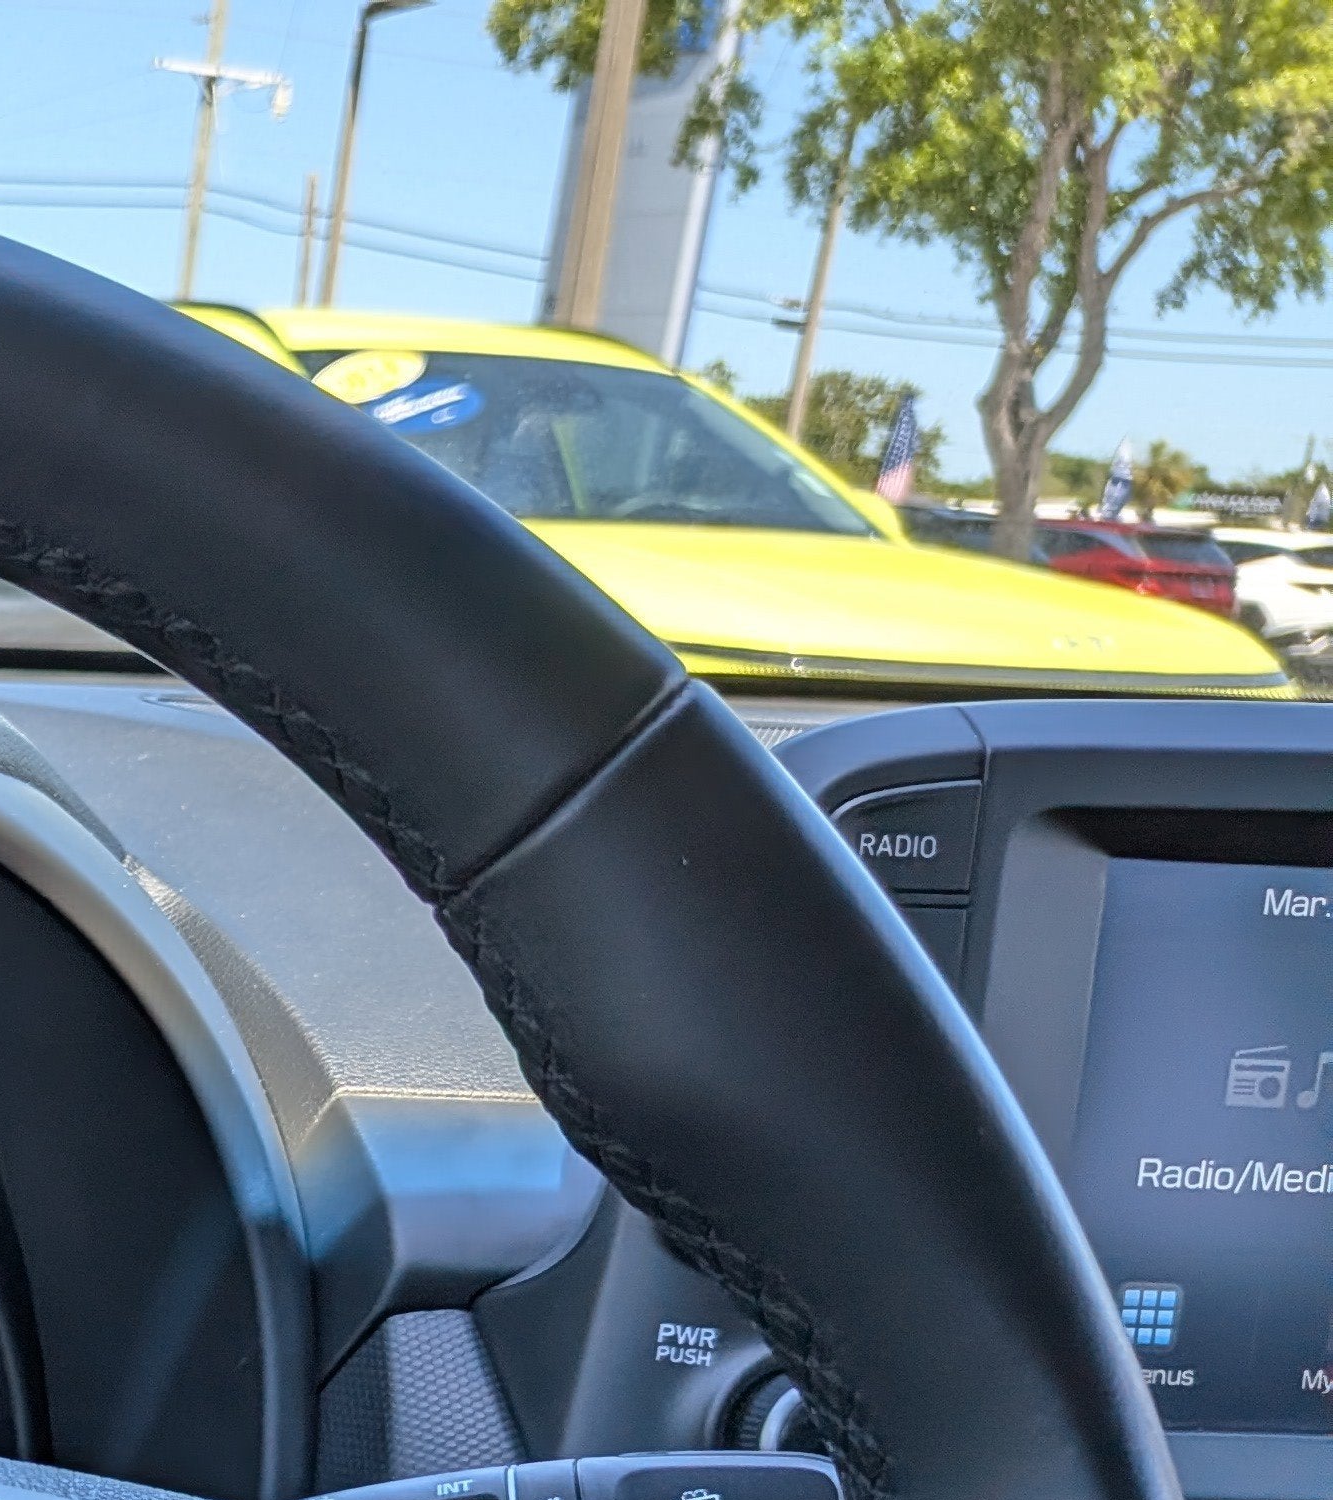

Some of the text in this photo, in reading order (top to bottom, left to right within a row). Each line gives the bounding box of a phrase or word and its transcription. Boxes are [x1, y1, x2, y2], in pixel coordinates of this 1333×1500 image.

[859, 833, 937, 858] RADIO
[1263, 888, 1332, 917] Mar.
[1137, 1158, 1333, 1194] Radio/Medi
[657, 1322, 717, 1349] PWR
[654, 1345, 713, 1367] PUSH
[1141, 1368, 1195, 1387] enus
[436, 1479, 473, 1496] INT
